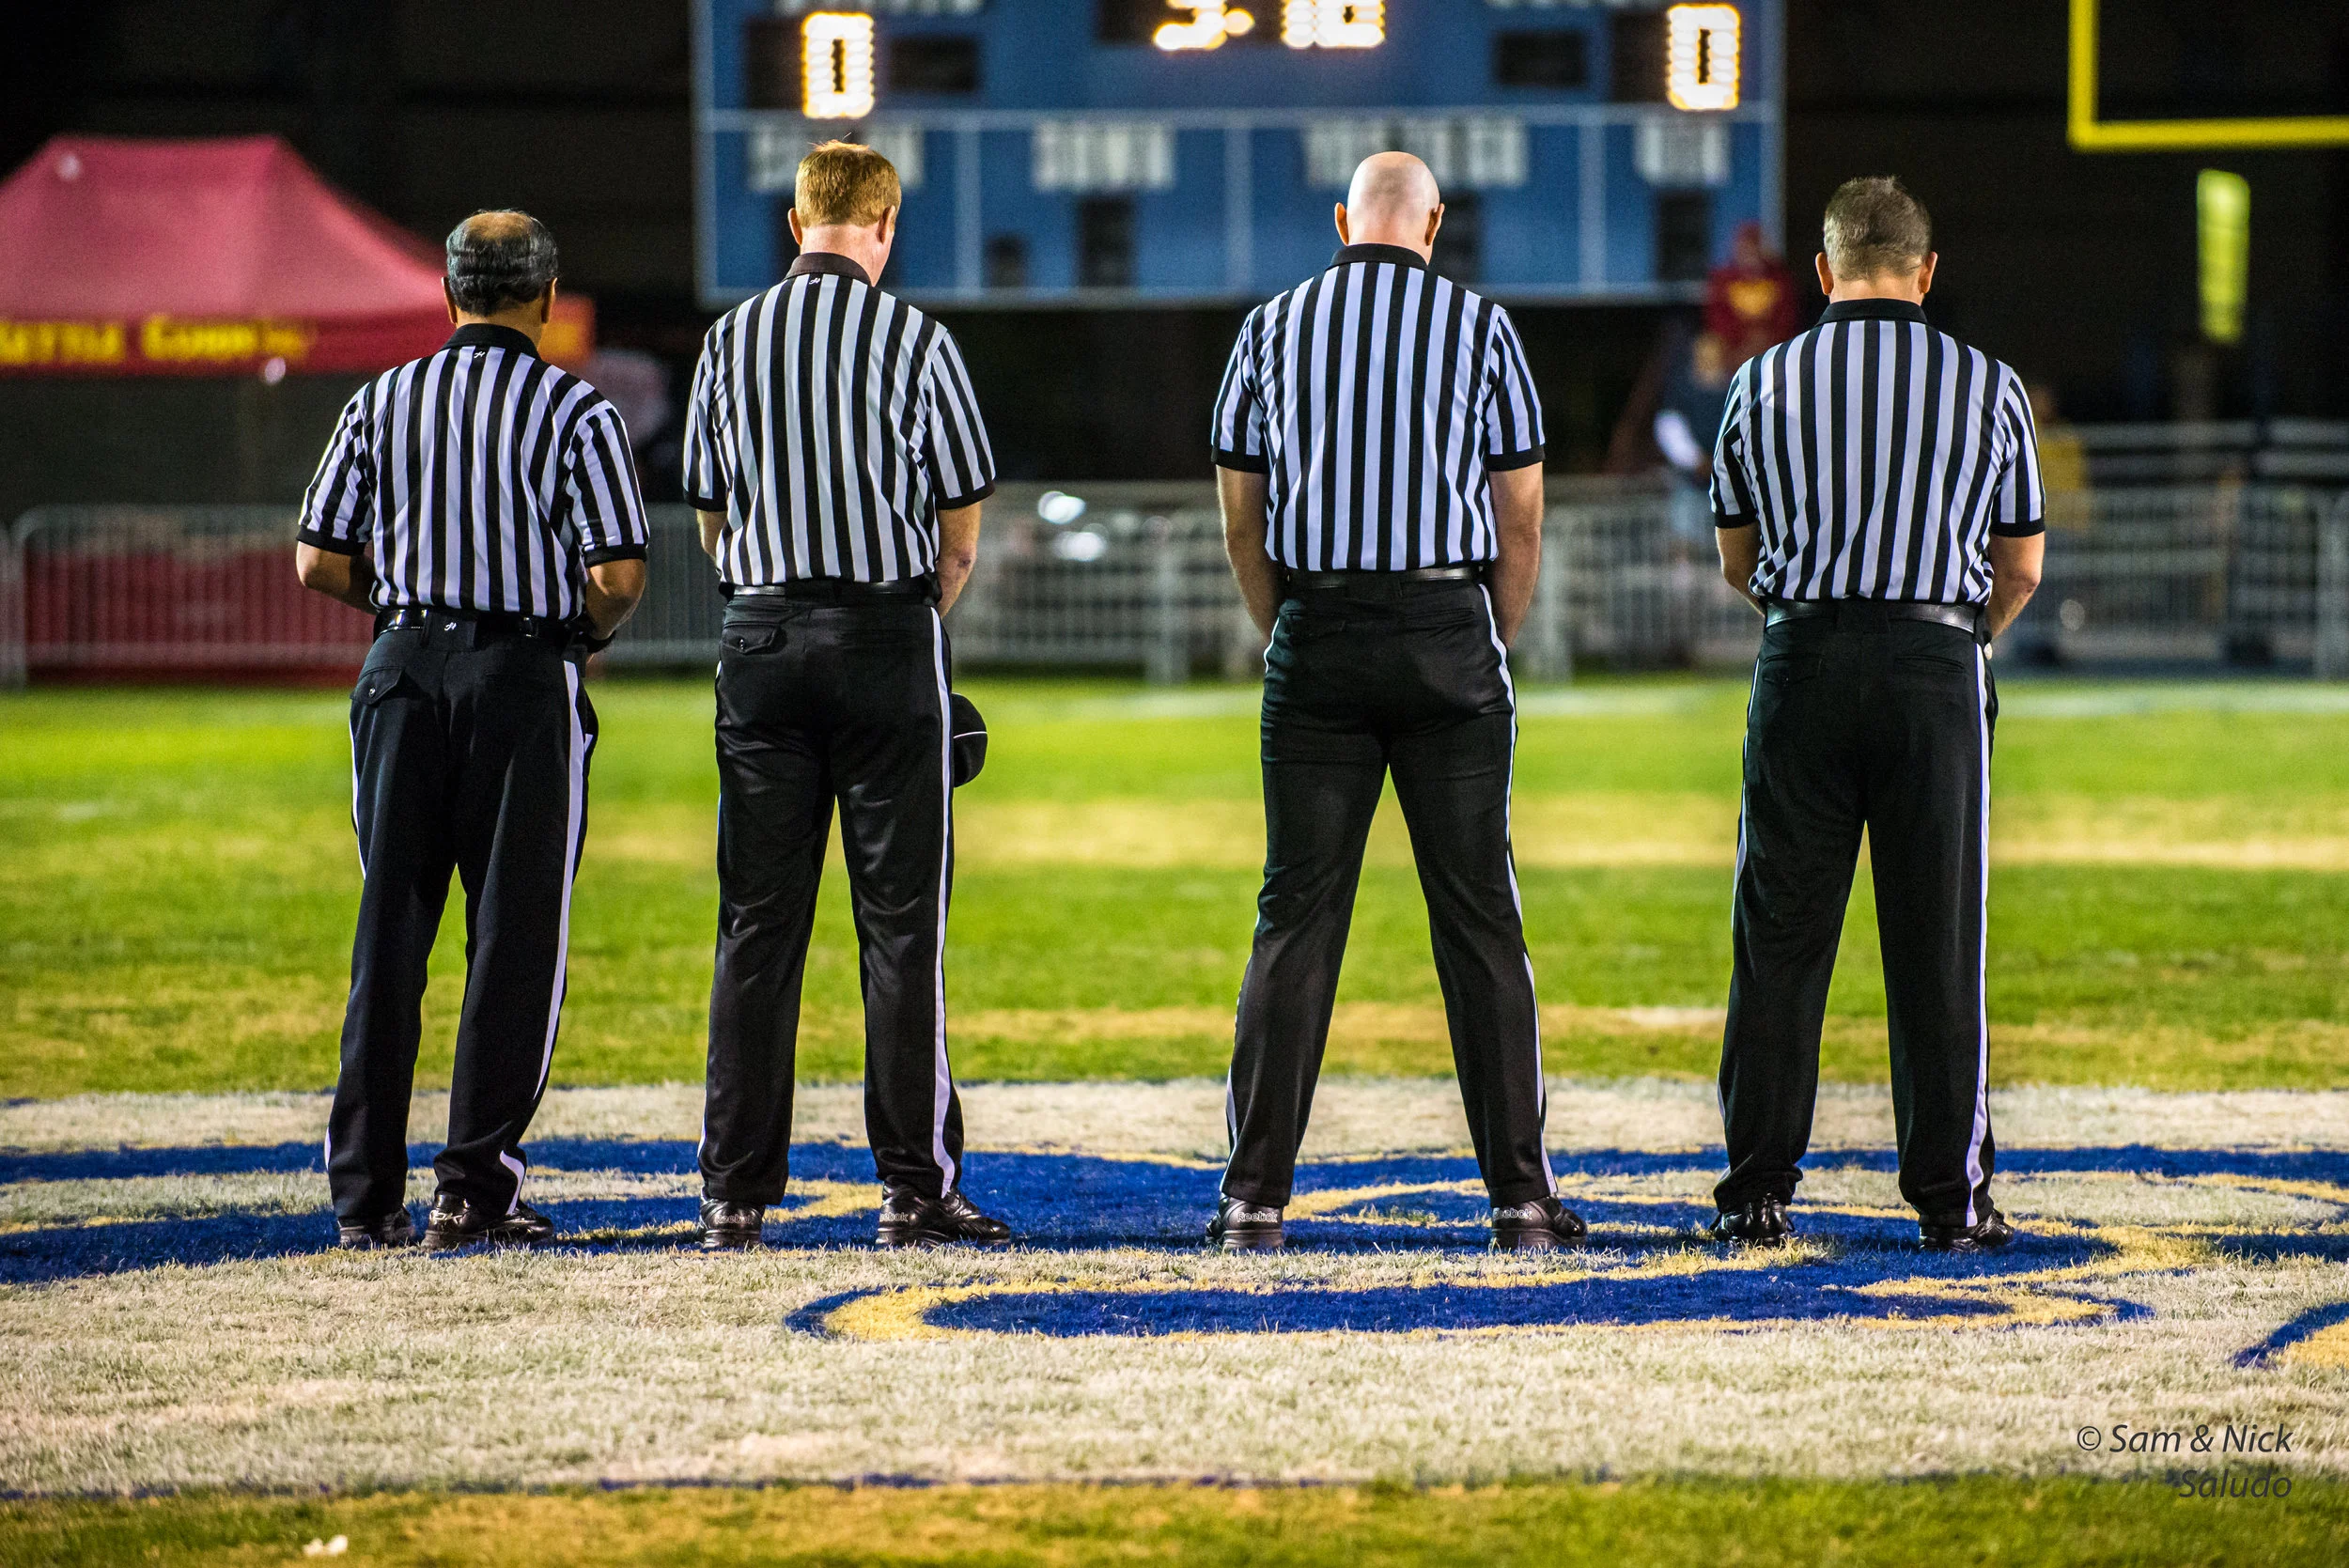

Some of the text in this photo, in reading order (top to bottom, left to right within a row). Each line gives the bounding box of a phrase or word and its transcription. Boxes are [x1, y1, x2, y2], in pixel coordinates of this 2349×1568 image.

[803, 11, 874, 118] 0
[1667, 3, 1740, 110] 0
[1237, 1211, 1278, 1222] Reebok
